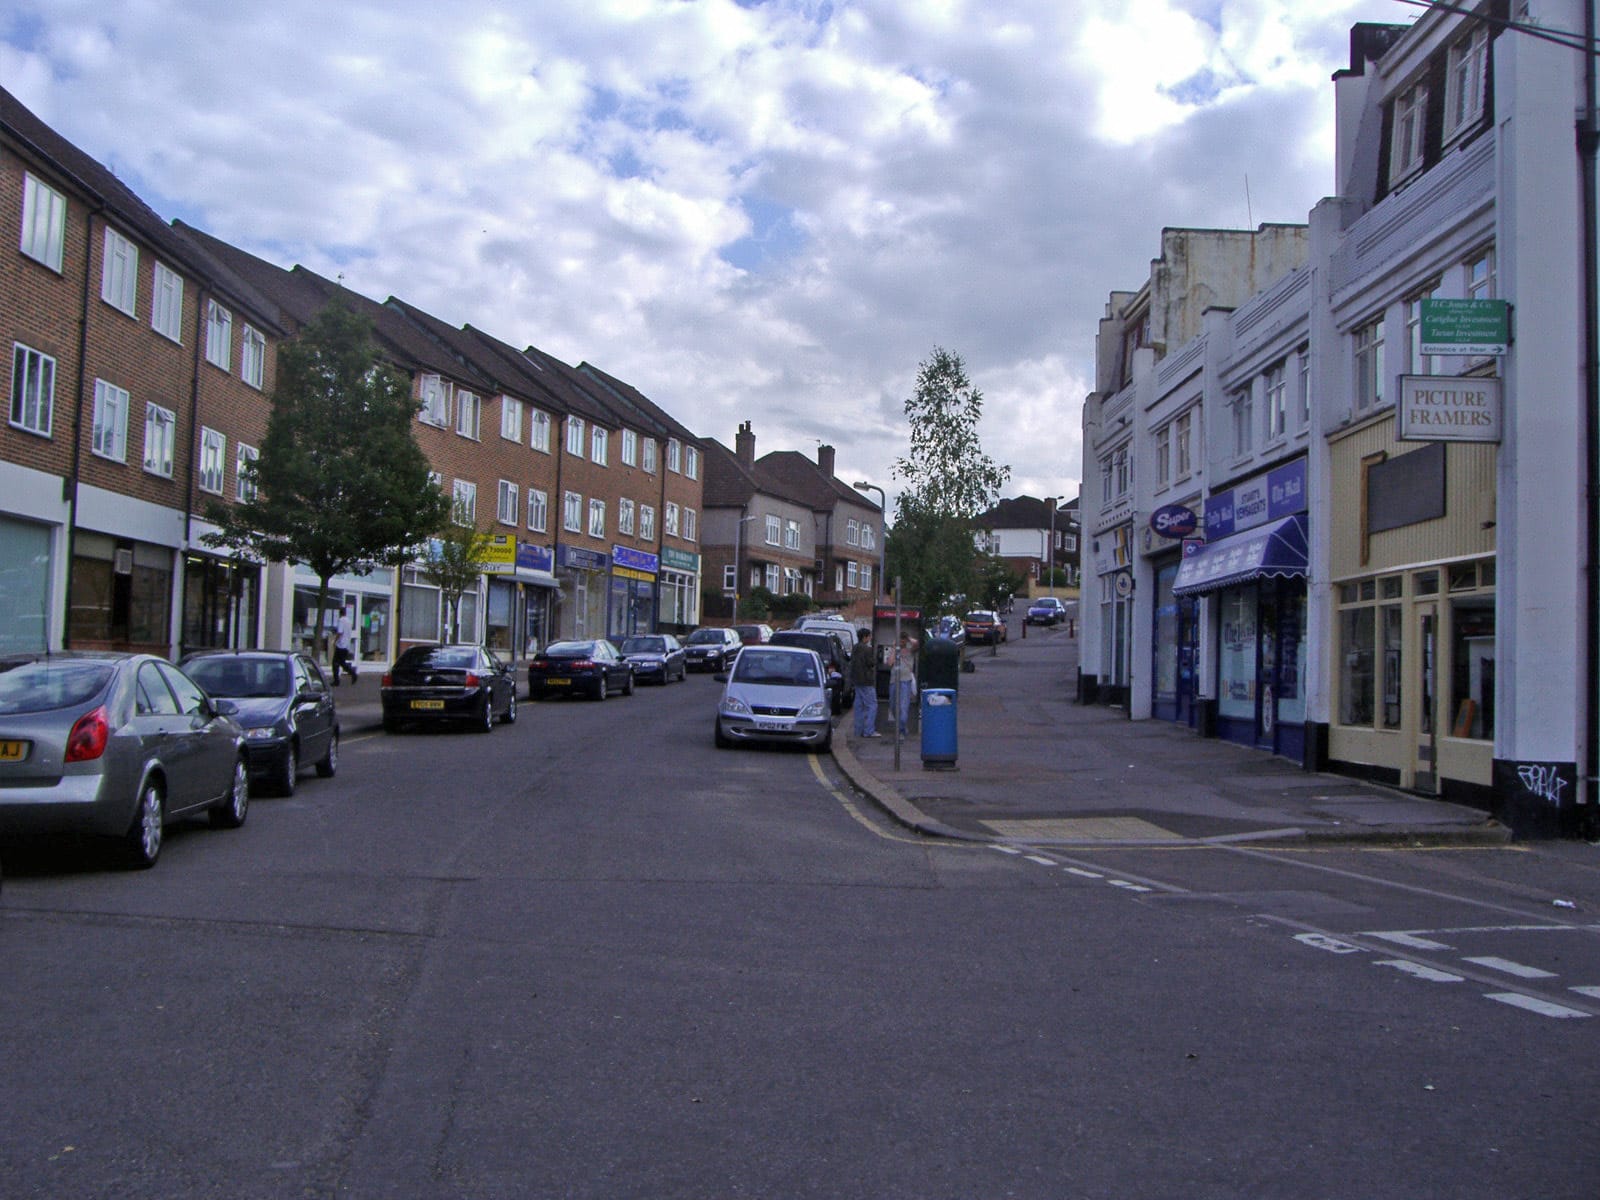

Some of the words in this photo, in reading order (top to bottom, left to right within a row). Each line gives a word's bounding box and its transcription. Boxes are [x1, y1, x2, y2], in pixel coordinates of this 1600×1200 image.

[1415, 390, 1487, 407] PICTURE
[1410, 409, 1492, 426] FRAMERS
[1156, 512, 1191, 530] Super
